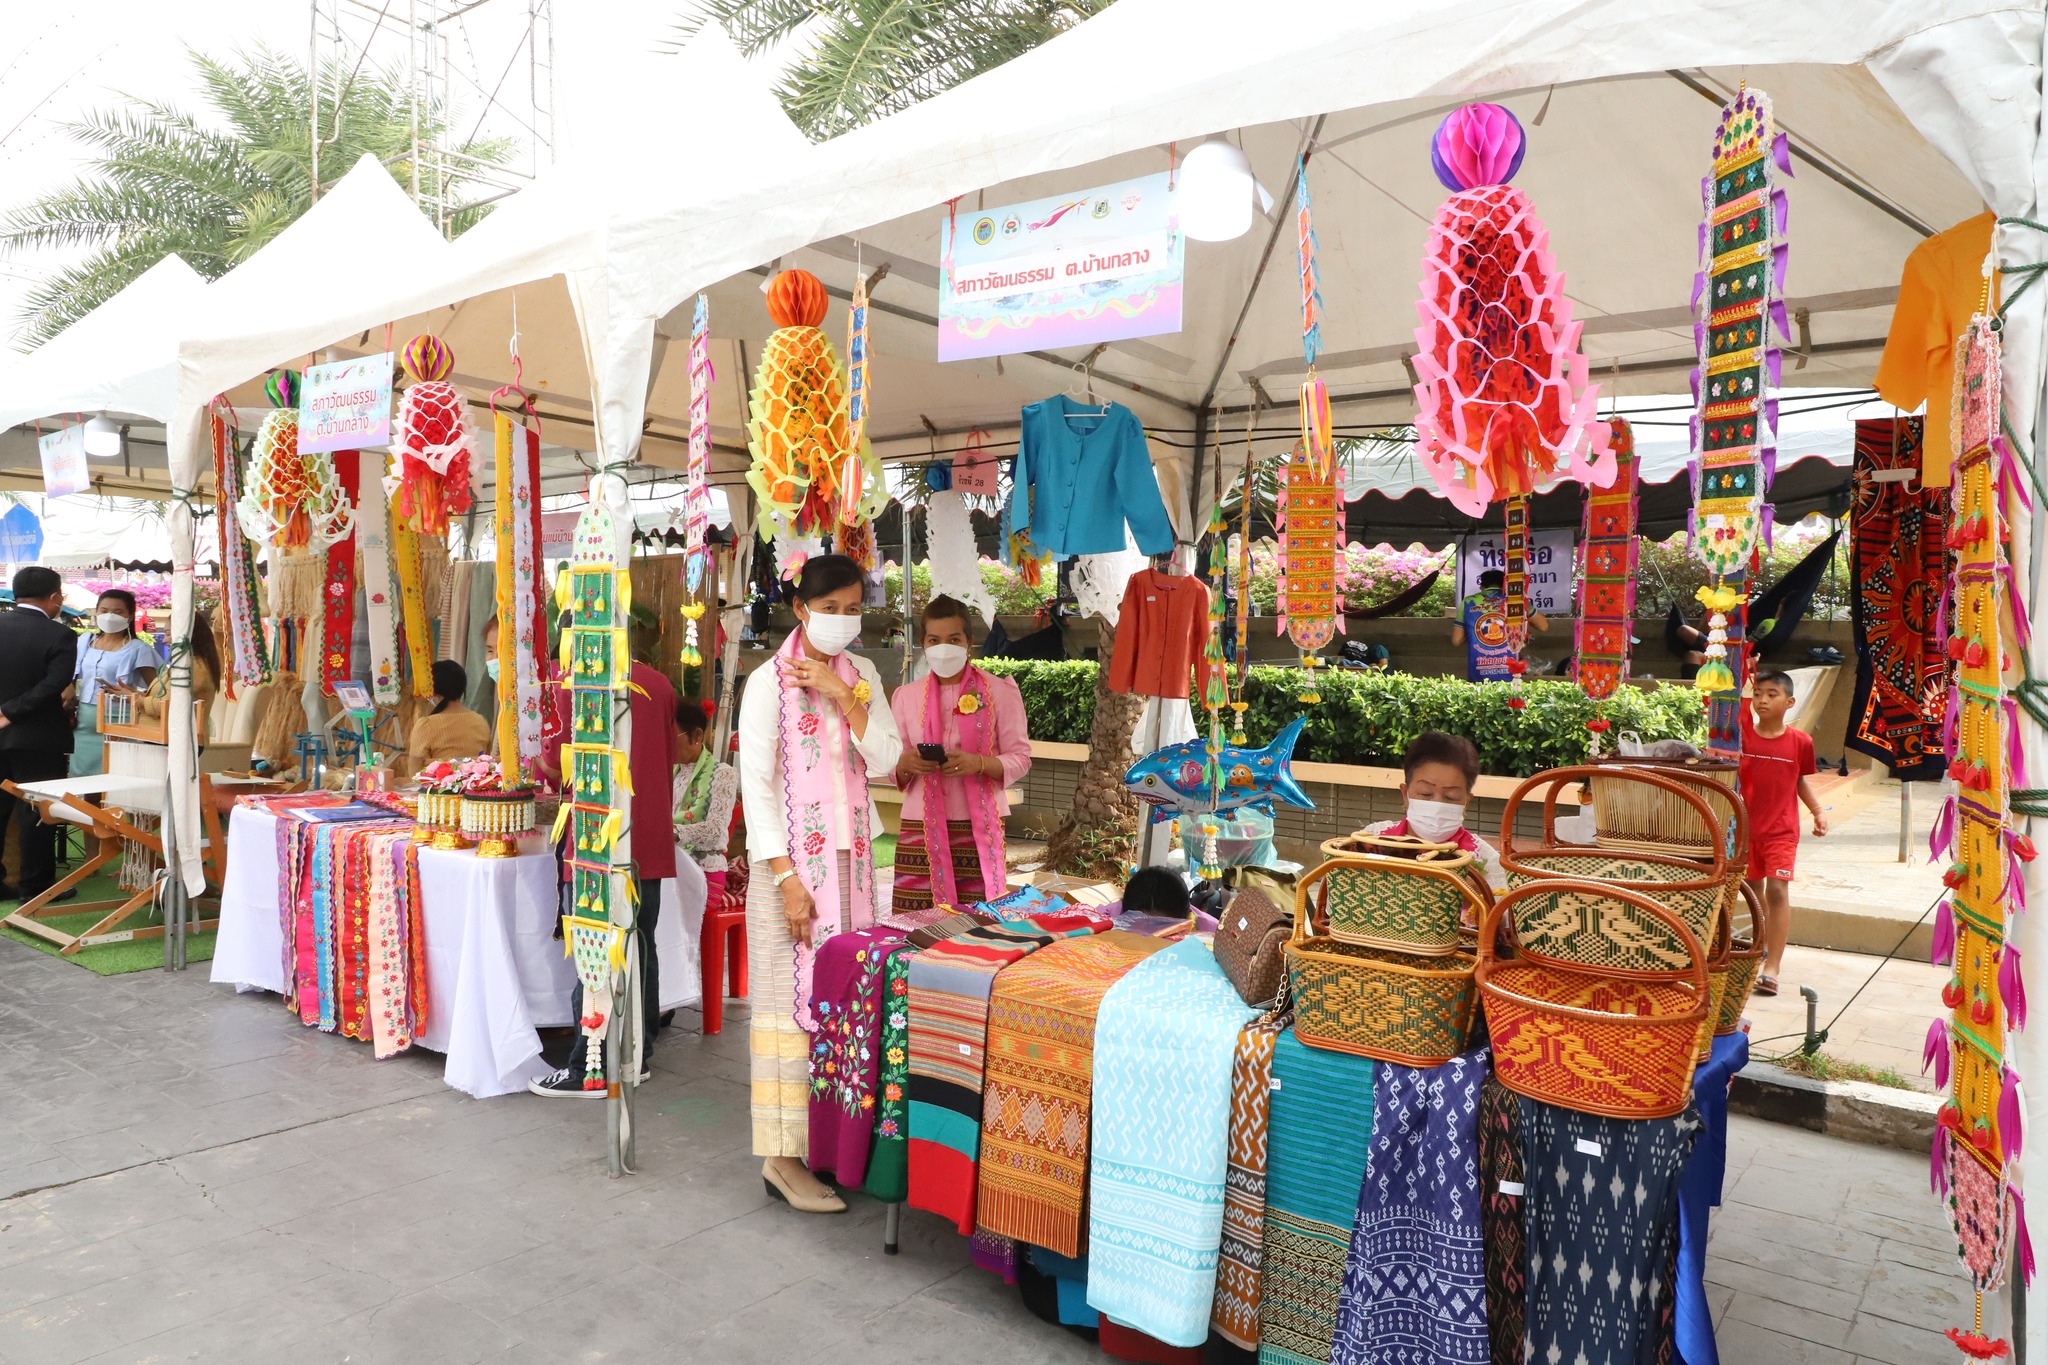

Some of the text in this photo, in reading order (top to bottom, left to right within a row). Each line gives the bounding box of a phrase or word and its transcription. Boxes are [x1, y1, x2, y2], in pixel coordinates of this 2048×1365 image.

[957, 248, 1150, 294] สภาวัฒนธรรม ต.บ้านกลาง
[312, 389, 376, 411] สภาวัฒนธรรม
[317, 416, 369, 435] ต.บ้านกลาง
[975, 479, 984, 487] 28
